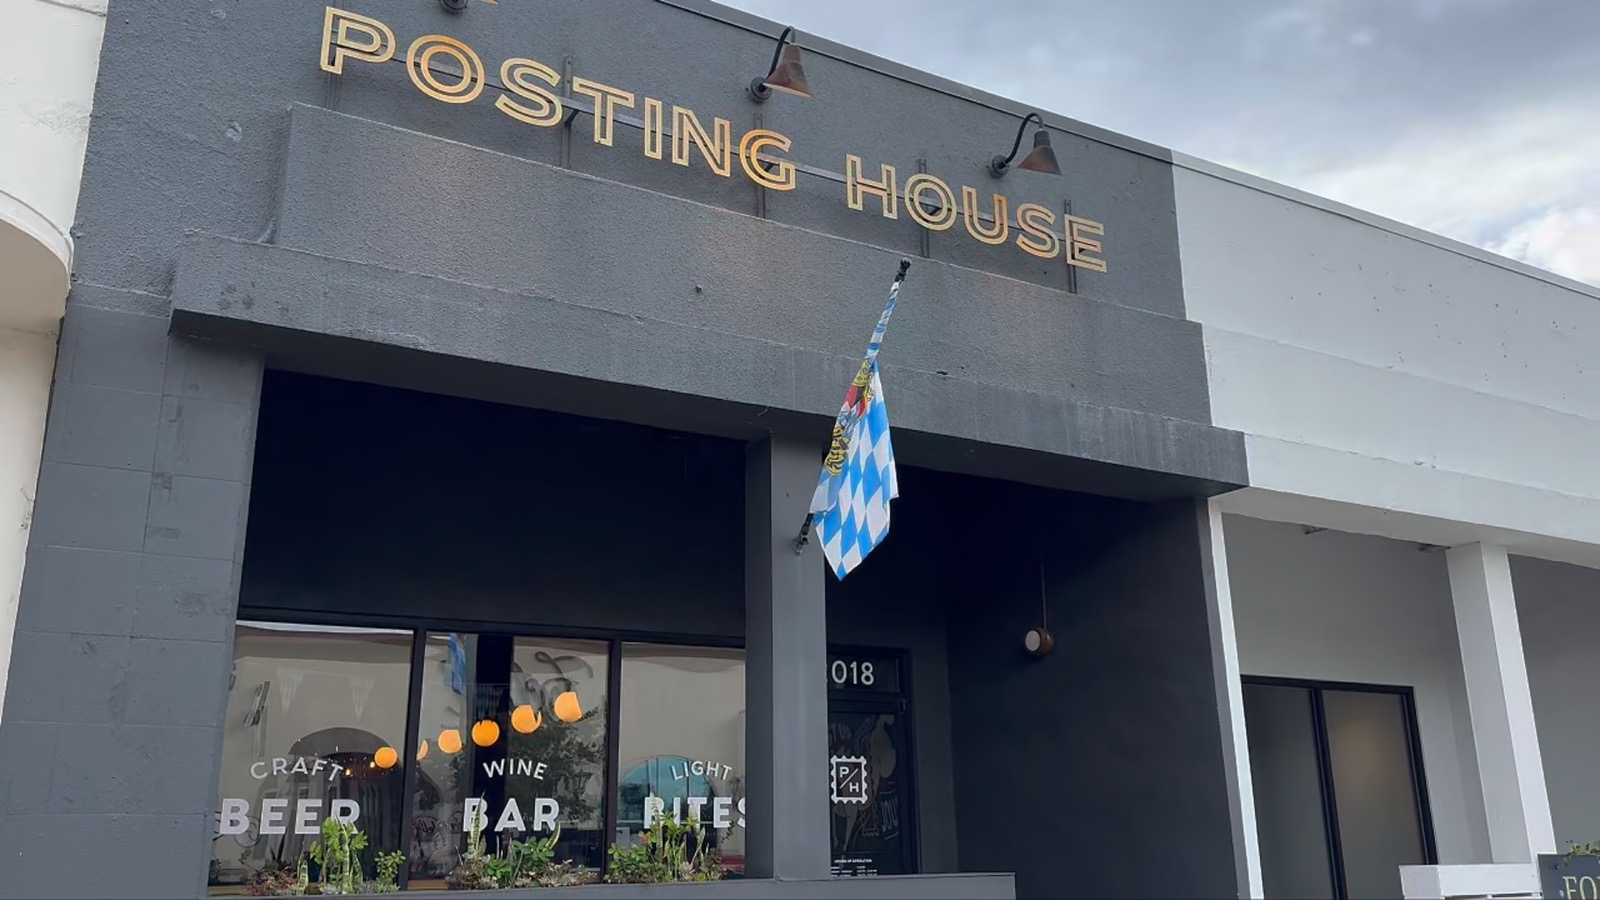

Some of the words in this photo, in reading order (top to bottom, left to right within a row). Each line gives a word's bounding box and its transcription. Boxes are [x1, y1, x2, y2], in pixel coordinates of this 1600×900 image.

[319, 6, 796, 191] POSTING
[845, 154, 1108, 273] HOUSE
[250, 756, 344, 782] CRAFT
[482, 757, 548, 781] WINE
[671, 760, 733, 781] LIGHT
[219, 798, 361, 835] BEER
[463, 797, 560, 832] BAR
[1562, 875, 1600, 900] FO
